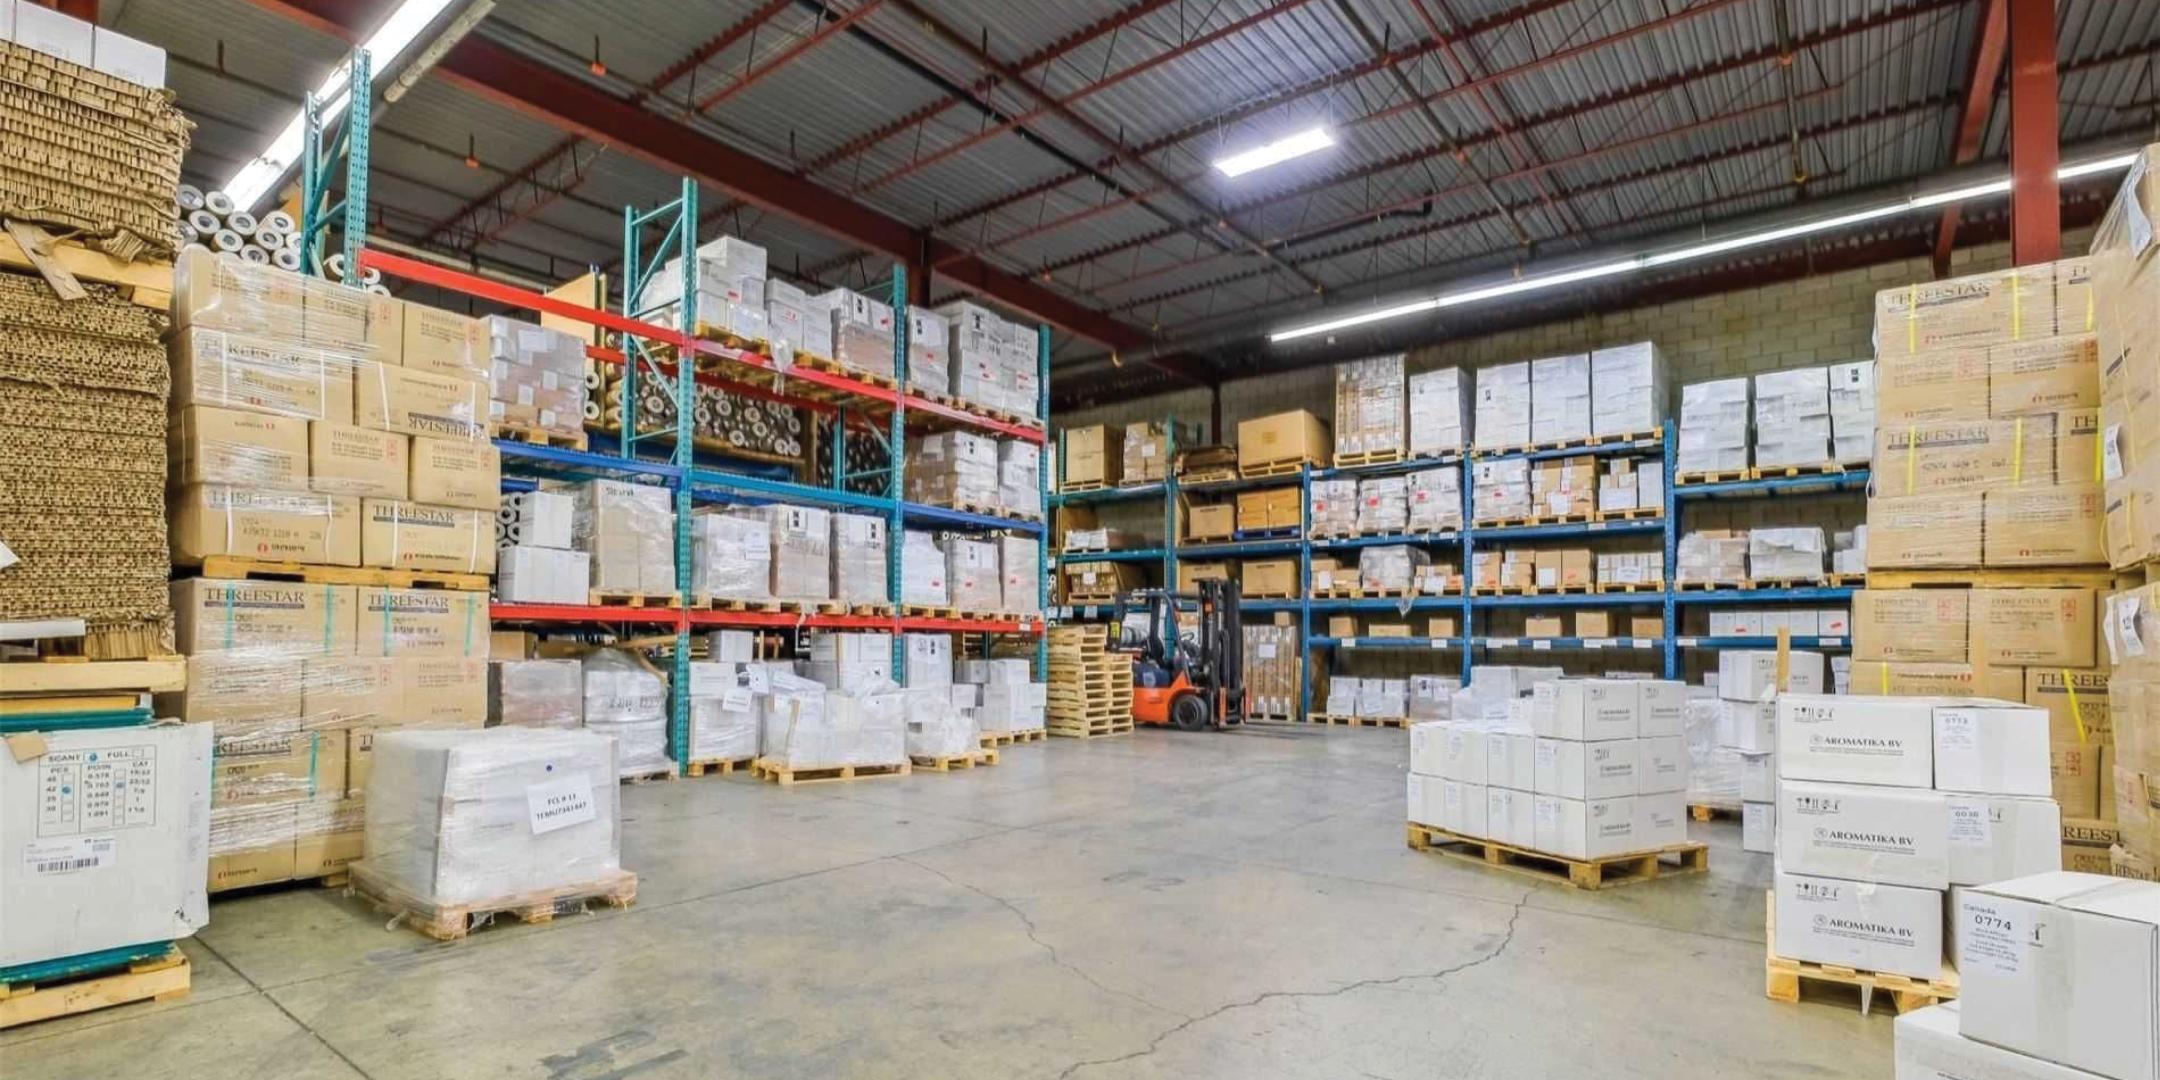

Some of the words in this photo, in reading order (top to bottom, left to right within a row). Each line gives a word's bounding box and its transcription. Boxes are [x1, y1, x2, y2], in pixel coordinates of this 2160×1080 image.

[373, 504, 455, 523] THREESTAR
[204, 587, 305, 604] THREESTAR
[368, 594, 449, 609] THREESTAR
[1825, 736, 1885, 747] AROMATIKA
[1888, 739, 1902, 748] BV
[107, 749, 132, 759] FULL
[1829, 830, 1896, 845] AROMATIKA
[1898, 836, 1914, 846] BV
[1964, 904, 1996, 914] Canada
[1829, 918, 1896, 935] AROMATIKA
[1898, 927, 1914, 938] BV
[1975, 916, 2011, 931] 0774
